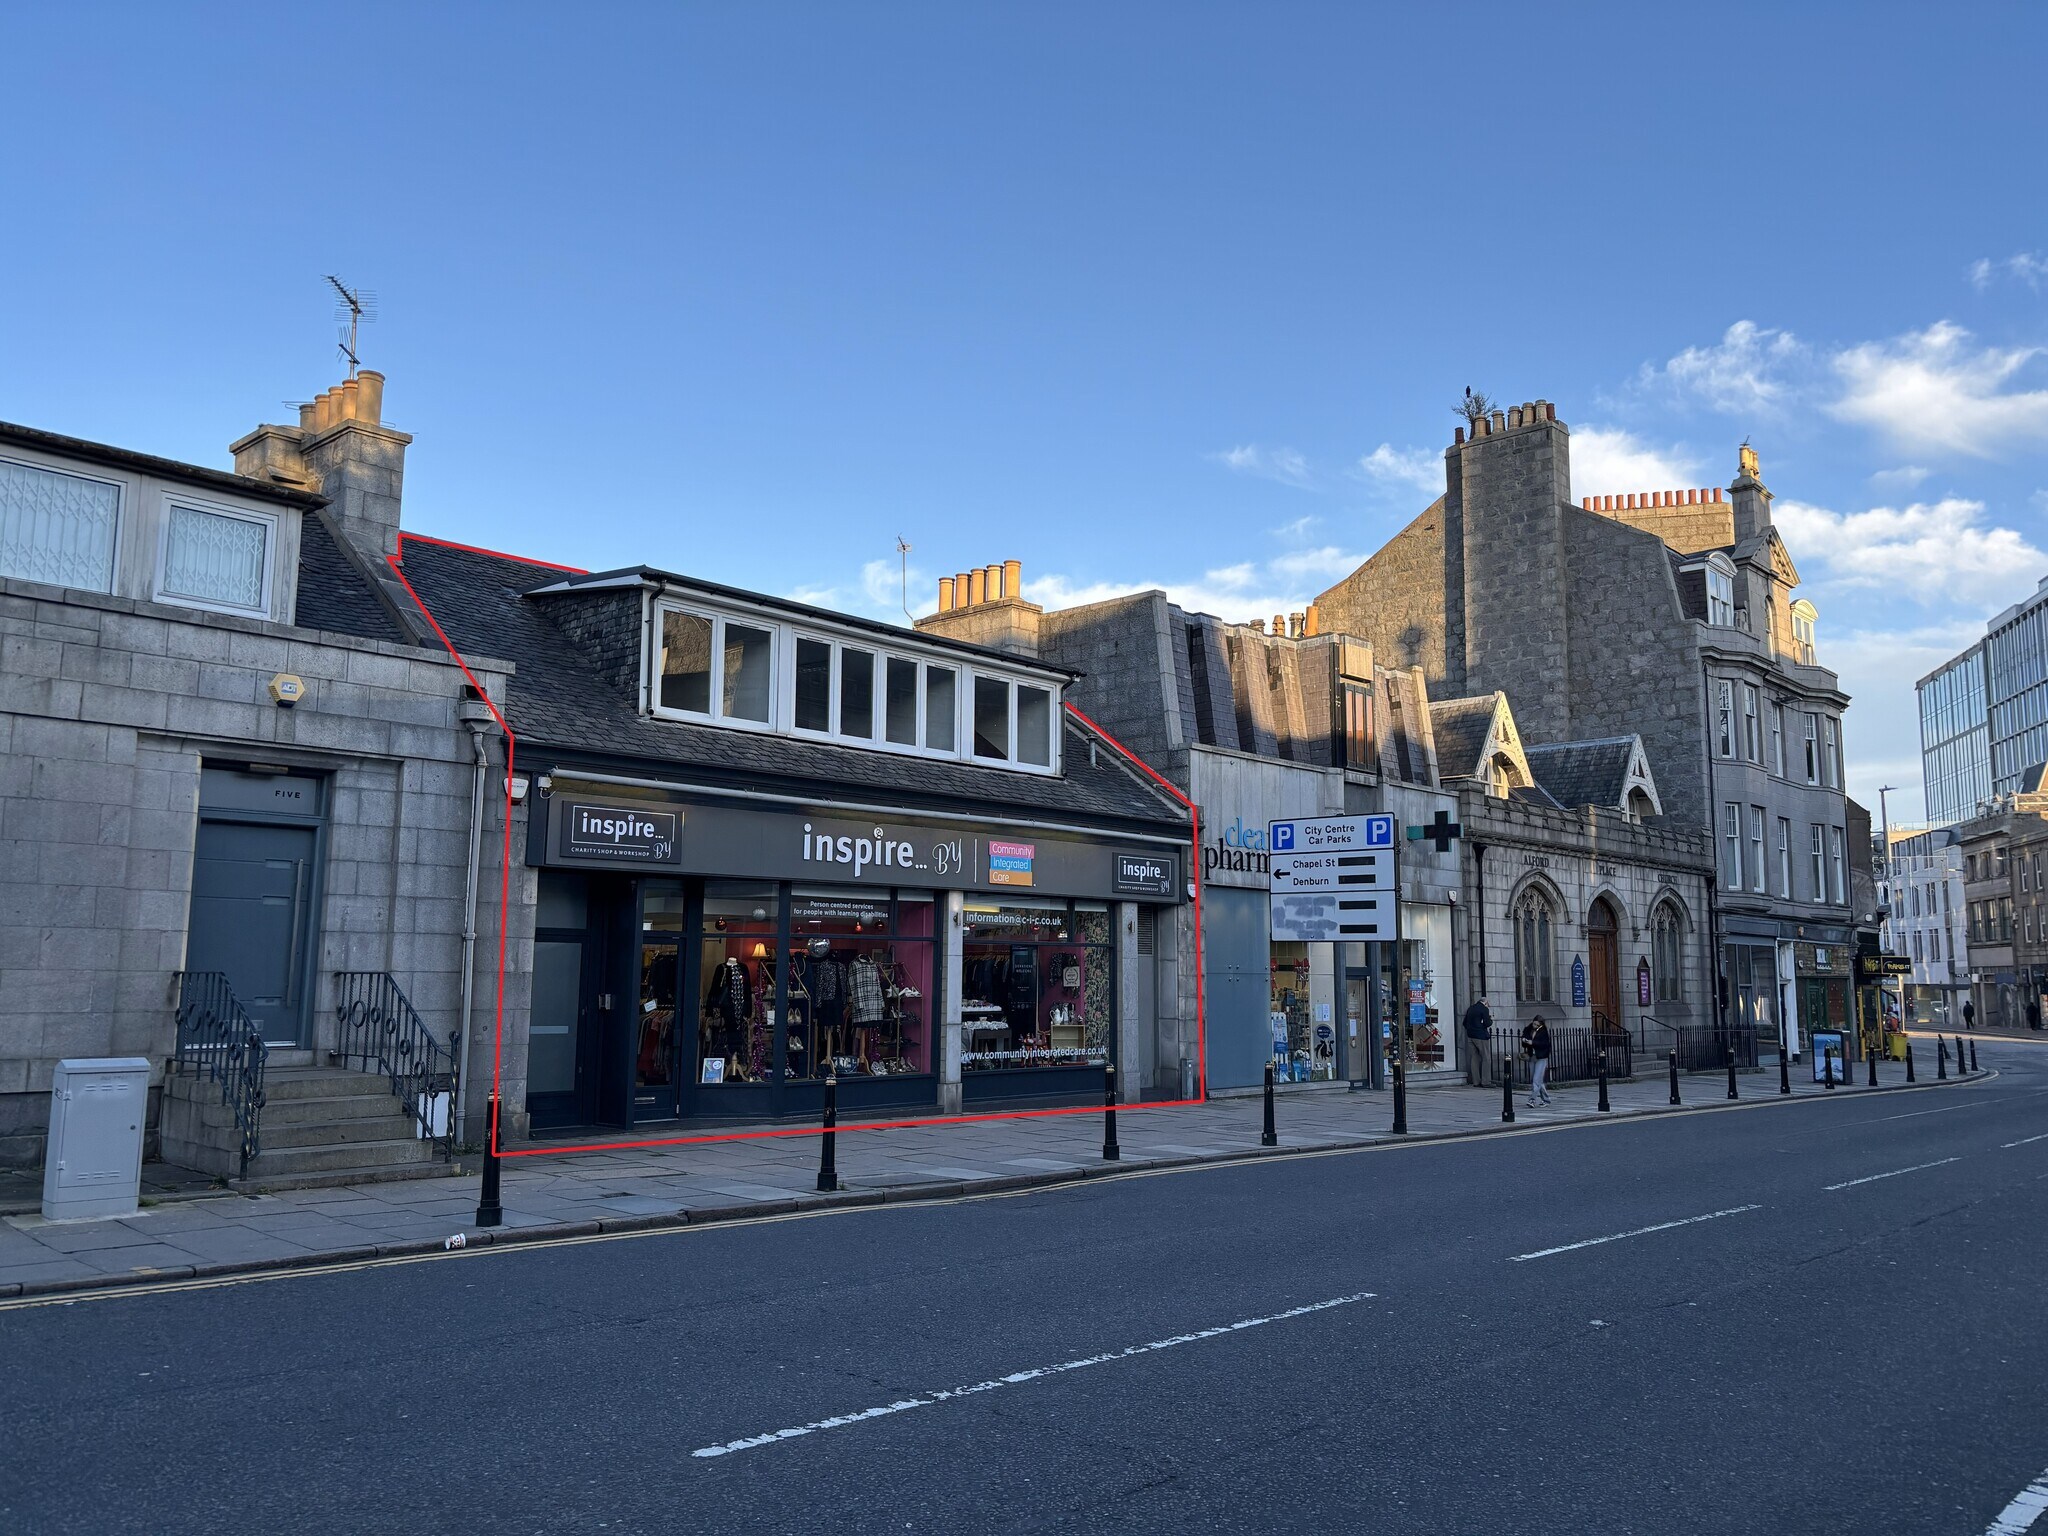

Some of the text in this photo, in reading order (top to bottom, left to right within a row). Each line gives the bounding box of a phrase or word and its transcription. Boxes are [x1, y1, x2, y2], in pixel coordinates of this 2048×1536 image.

[282, 683, 297, 693] ADT
[275, 790, 300, 799] FIVE
[582, 811, 664, 843] inspire...
[1304, 824, 1355, 836] City Centre
[1372, 820, 1387, 843] P
[1225, 816, 1268, 851] clea
[1278, 826, 1291, 848] P
[1308, 835, 1352, 845] Car Parks
[571, 846, 597, 854] CHARITY
[653, 841, 672, 859] BY
[803, 823, 962, 878] inspire... BY
[992, 843, 1032, 859] Community
[993, 857, 1029, 871] Integrated
[1292, 858, 1336, 869] Chapel St
[1523, 855, 1550, 868] ALFORD
[992, 871, 1010, 882] Care
[1599, 865, 1617, 877] PLACE
[1293, 877, 1329, 886] Denburn
[1657, 873, 1678, 884] CHURCH
[803, 908, 823, 916] people
[837, 910, 859, 918] learning
[966, 912, 1062, 926] information@c-i-c.co.uk
[1411, 990, 1423, 998] FREE
[960, 1045, 1107, 1060] www.communityintegratedcare.co.uk
